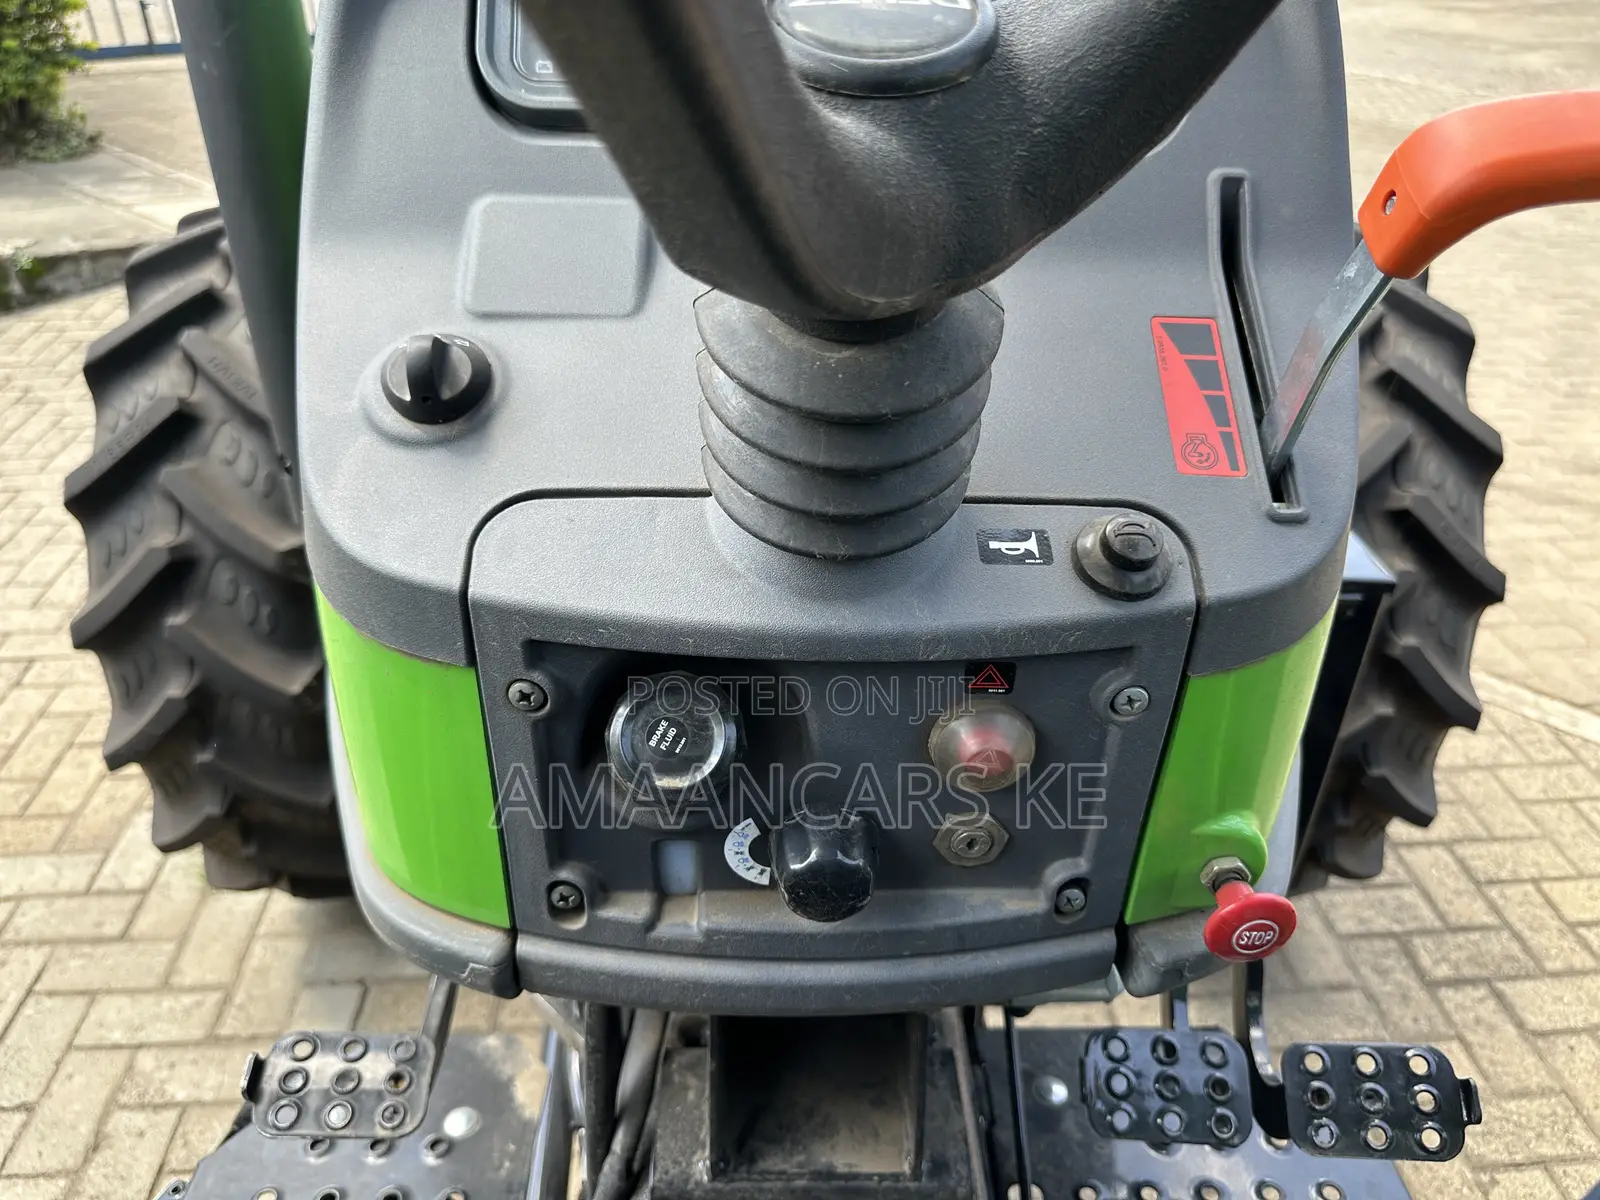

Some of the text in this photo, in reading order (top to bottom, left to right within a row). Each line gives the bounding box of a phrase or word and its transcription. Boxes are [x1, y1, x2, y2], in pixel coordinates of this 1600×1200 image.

[648, 719, 669, 748] BRAKE
[660, 727, 677, 751] FLUID
[1238, 930, 1274, 946] STOP
